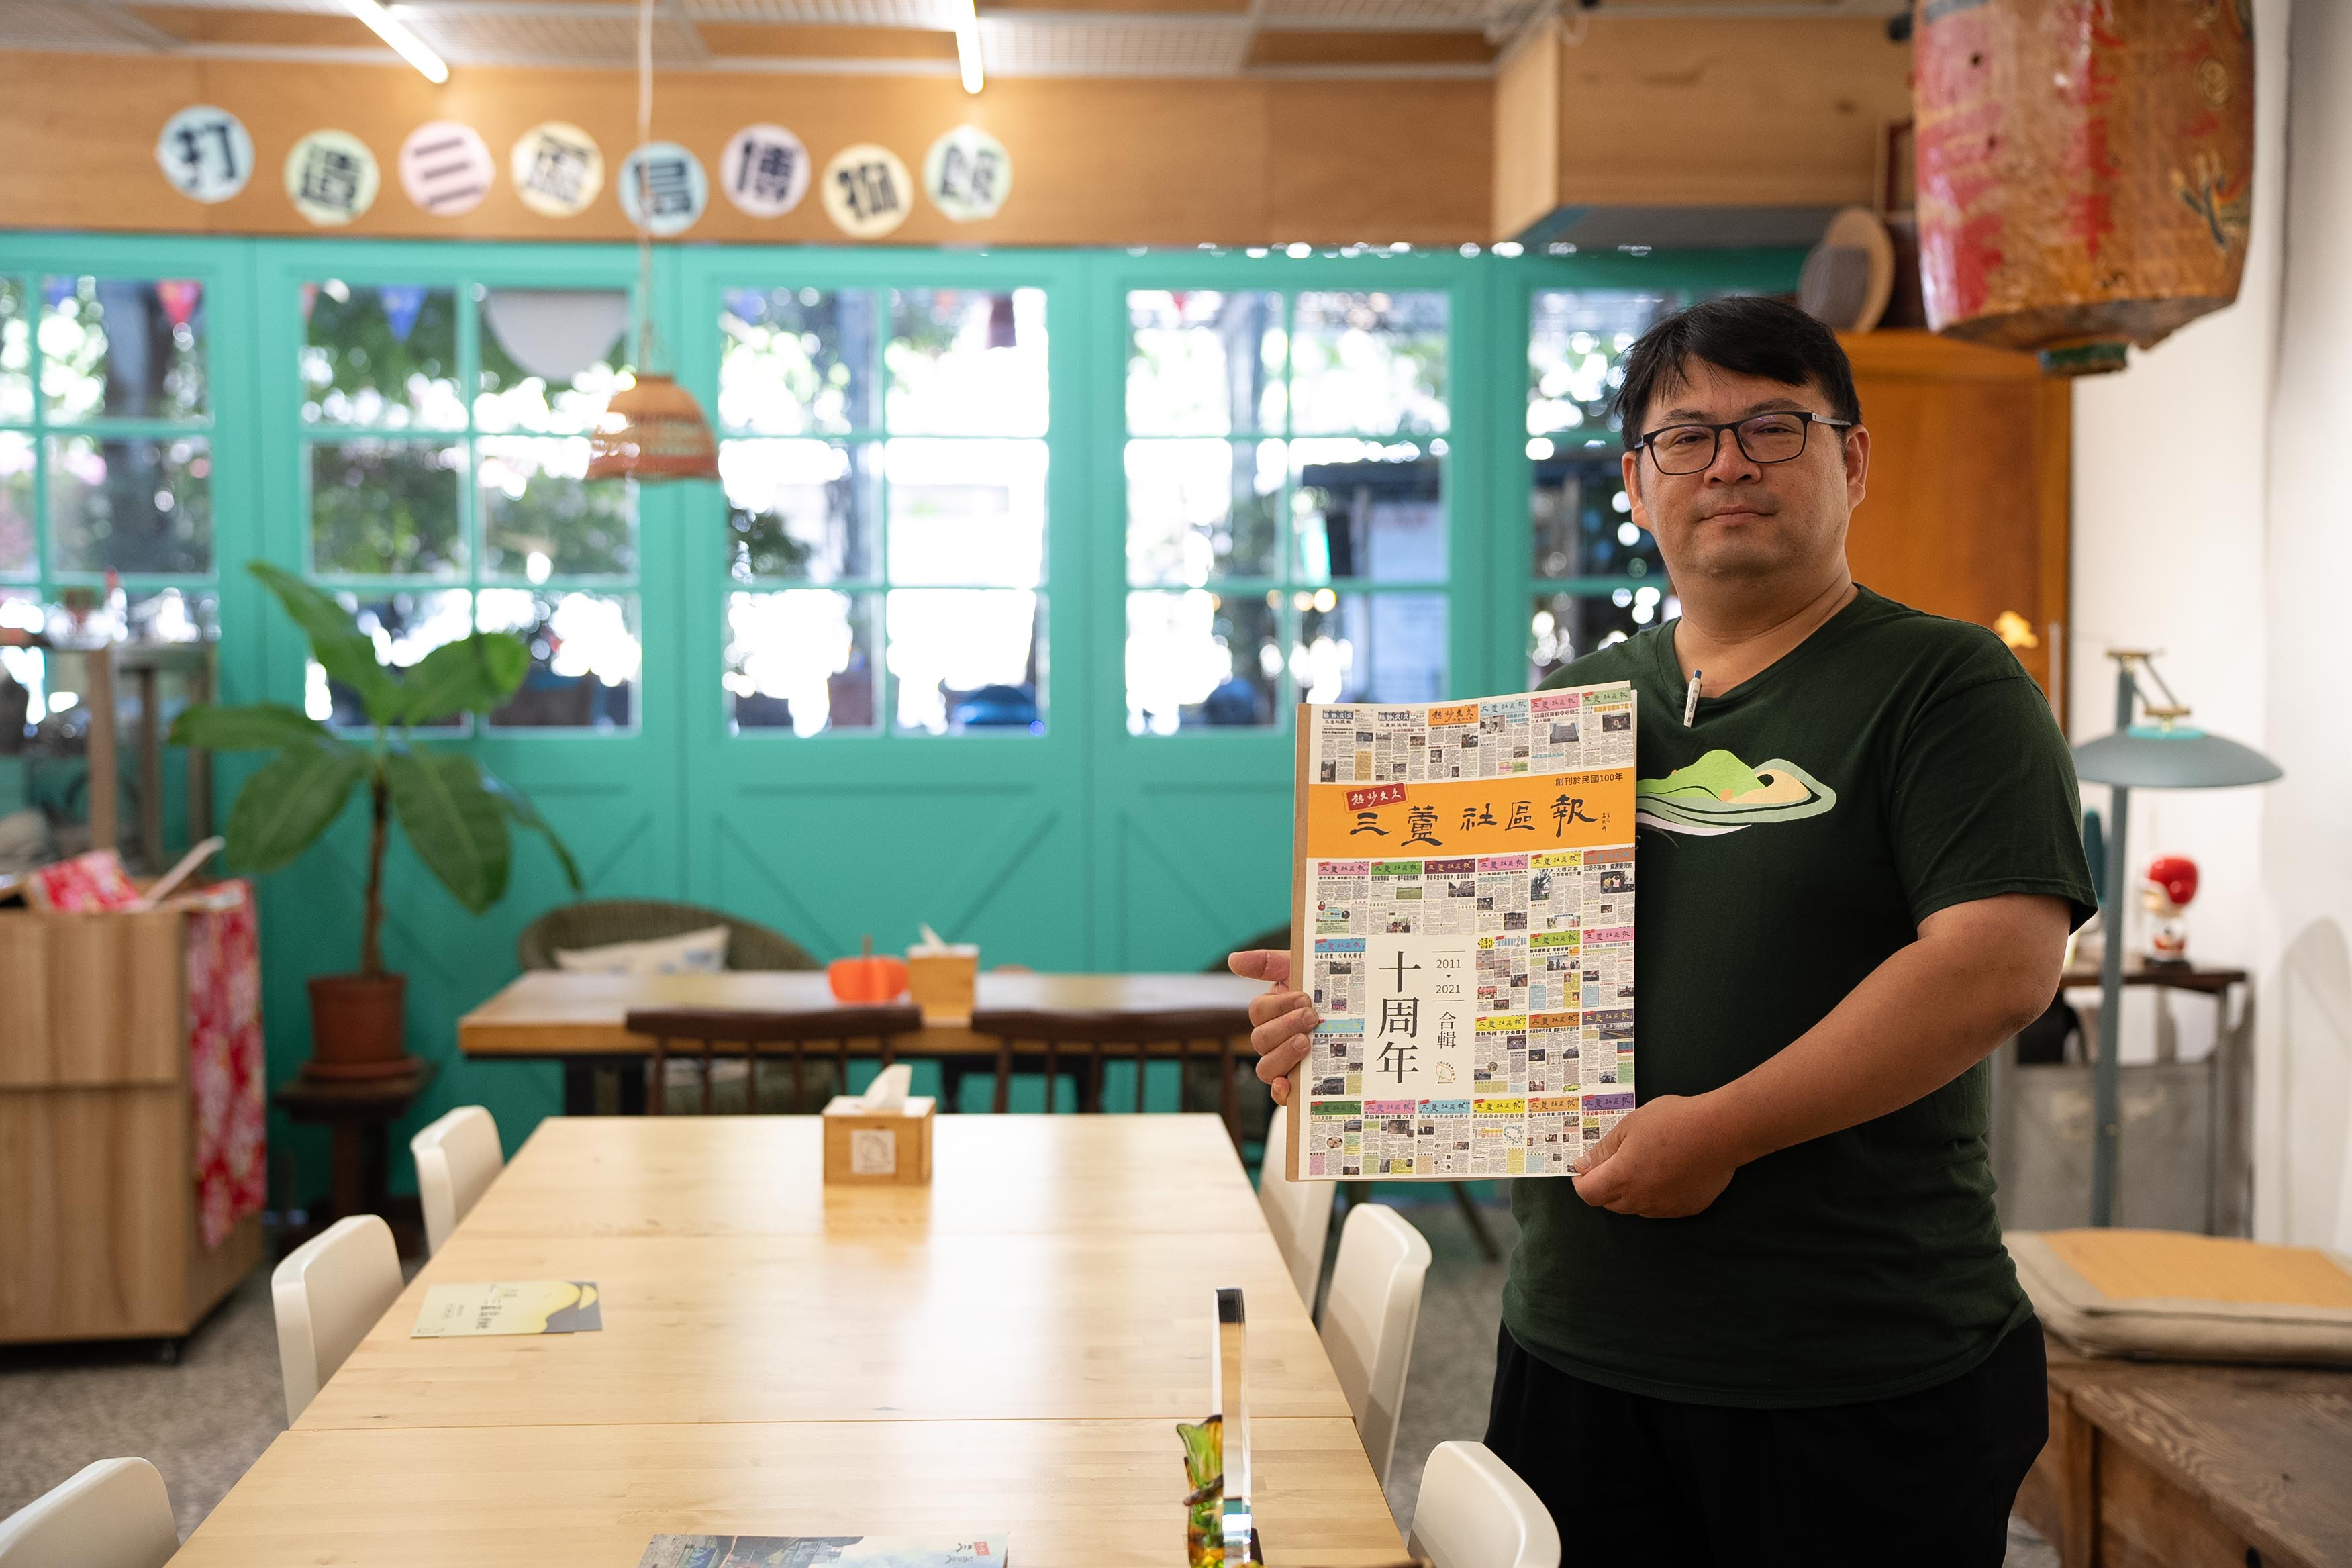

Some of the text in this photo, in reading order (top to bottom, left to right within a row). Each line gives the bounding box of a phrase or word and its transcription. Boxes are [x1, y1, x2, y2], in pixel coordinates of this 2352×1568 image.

[1555, 773, 1623, 787] 創刊於民國100年
[1351, 788, 1403, 806] 熱炒久久
[1349, 794, 1598, 847] 三蘆社區報
[1436, 959, 1461, 969] 2011
[1436, 984, 1460, 994] 2021
[1376, 951, 1421, 1083] 十周年
[1436, 1011, 1457, 1049] 合輯
